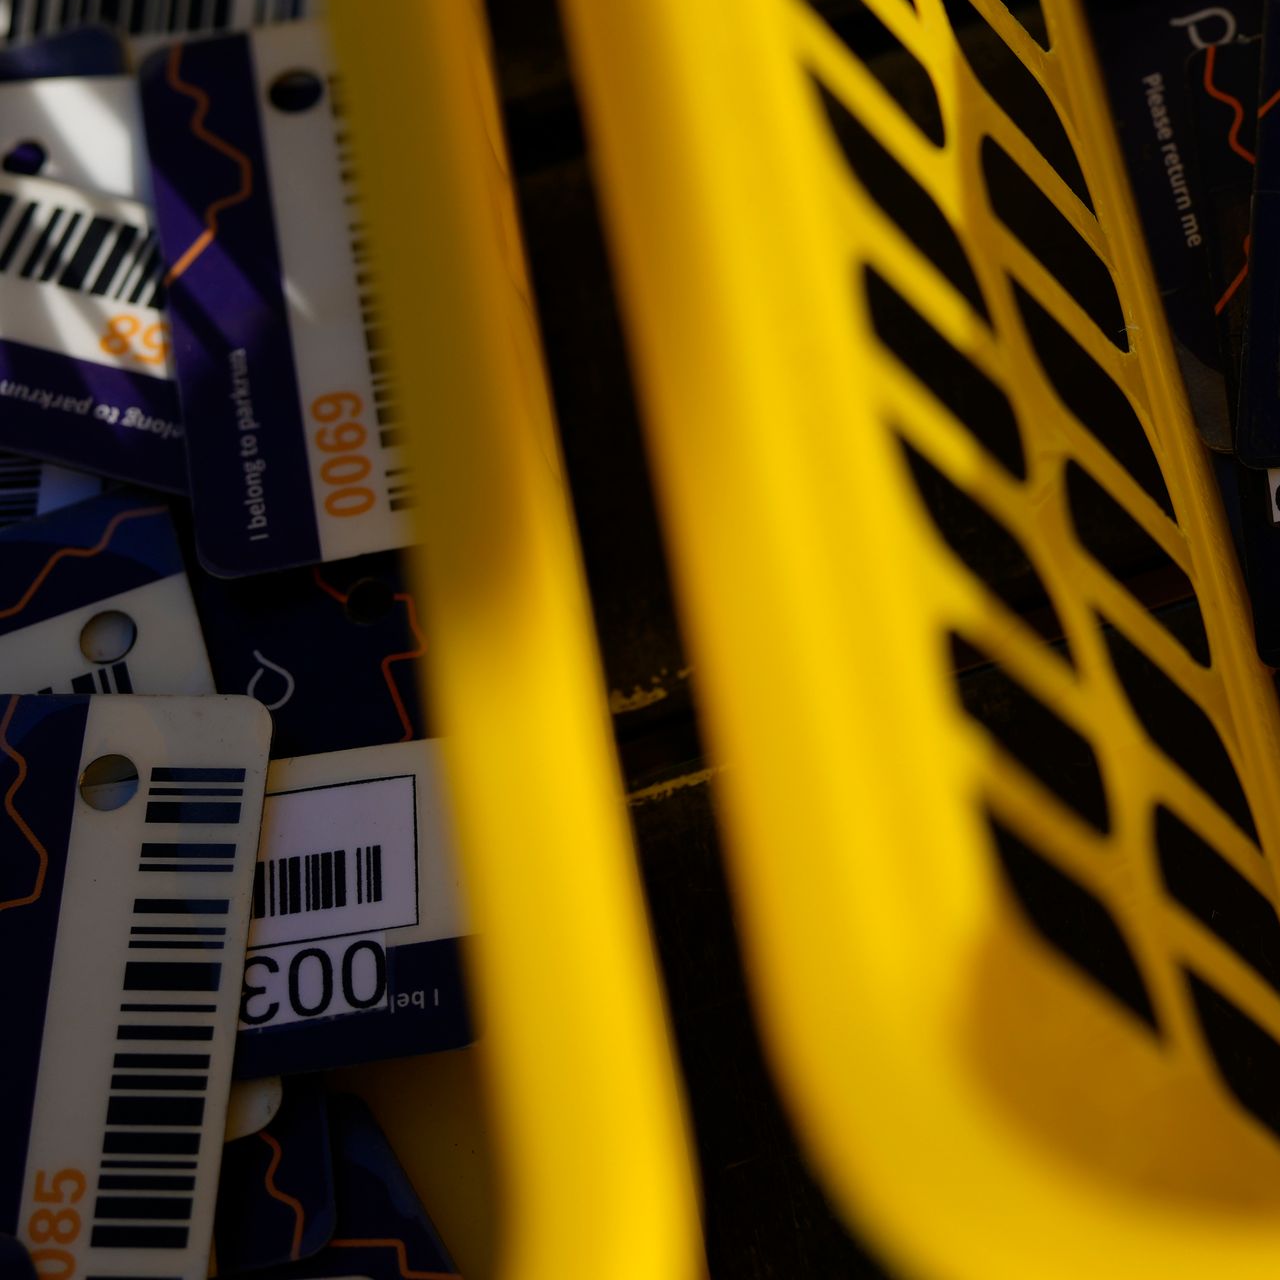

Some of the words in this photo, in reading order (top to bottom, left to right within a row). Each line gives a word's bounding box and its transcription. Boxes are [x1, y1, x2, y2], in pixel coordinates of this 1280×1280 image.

[1141, 71, 1174, 142] Please
[1160, 142, 1193, 211] return
[1180, 212, 1203, 249] me
[0, 378, 94, 417] parkrun
[92, 402, 121, 425] to
[227, 346, 263, 432] parkrun
[239, 433, 260, 458] to
[311, 391, 376, 518] 0069
[242, 457, 269, 531] belong
[238, 939, 388, 1025] 003
